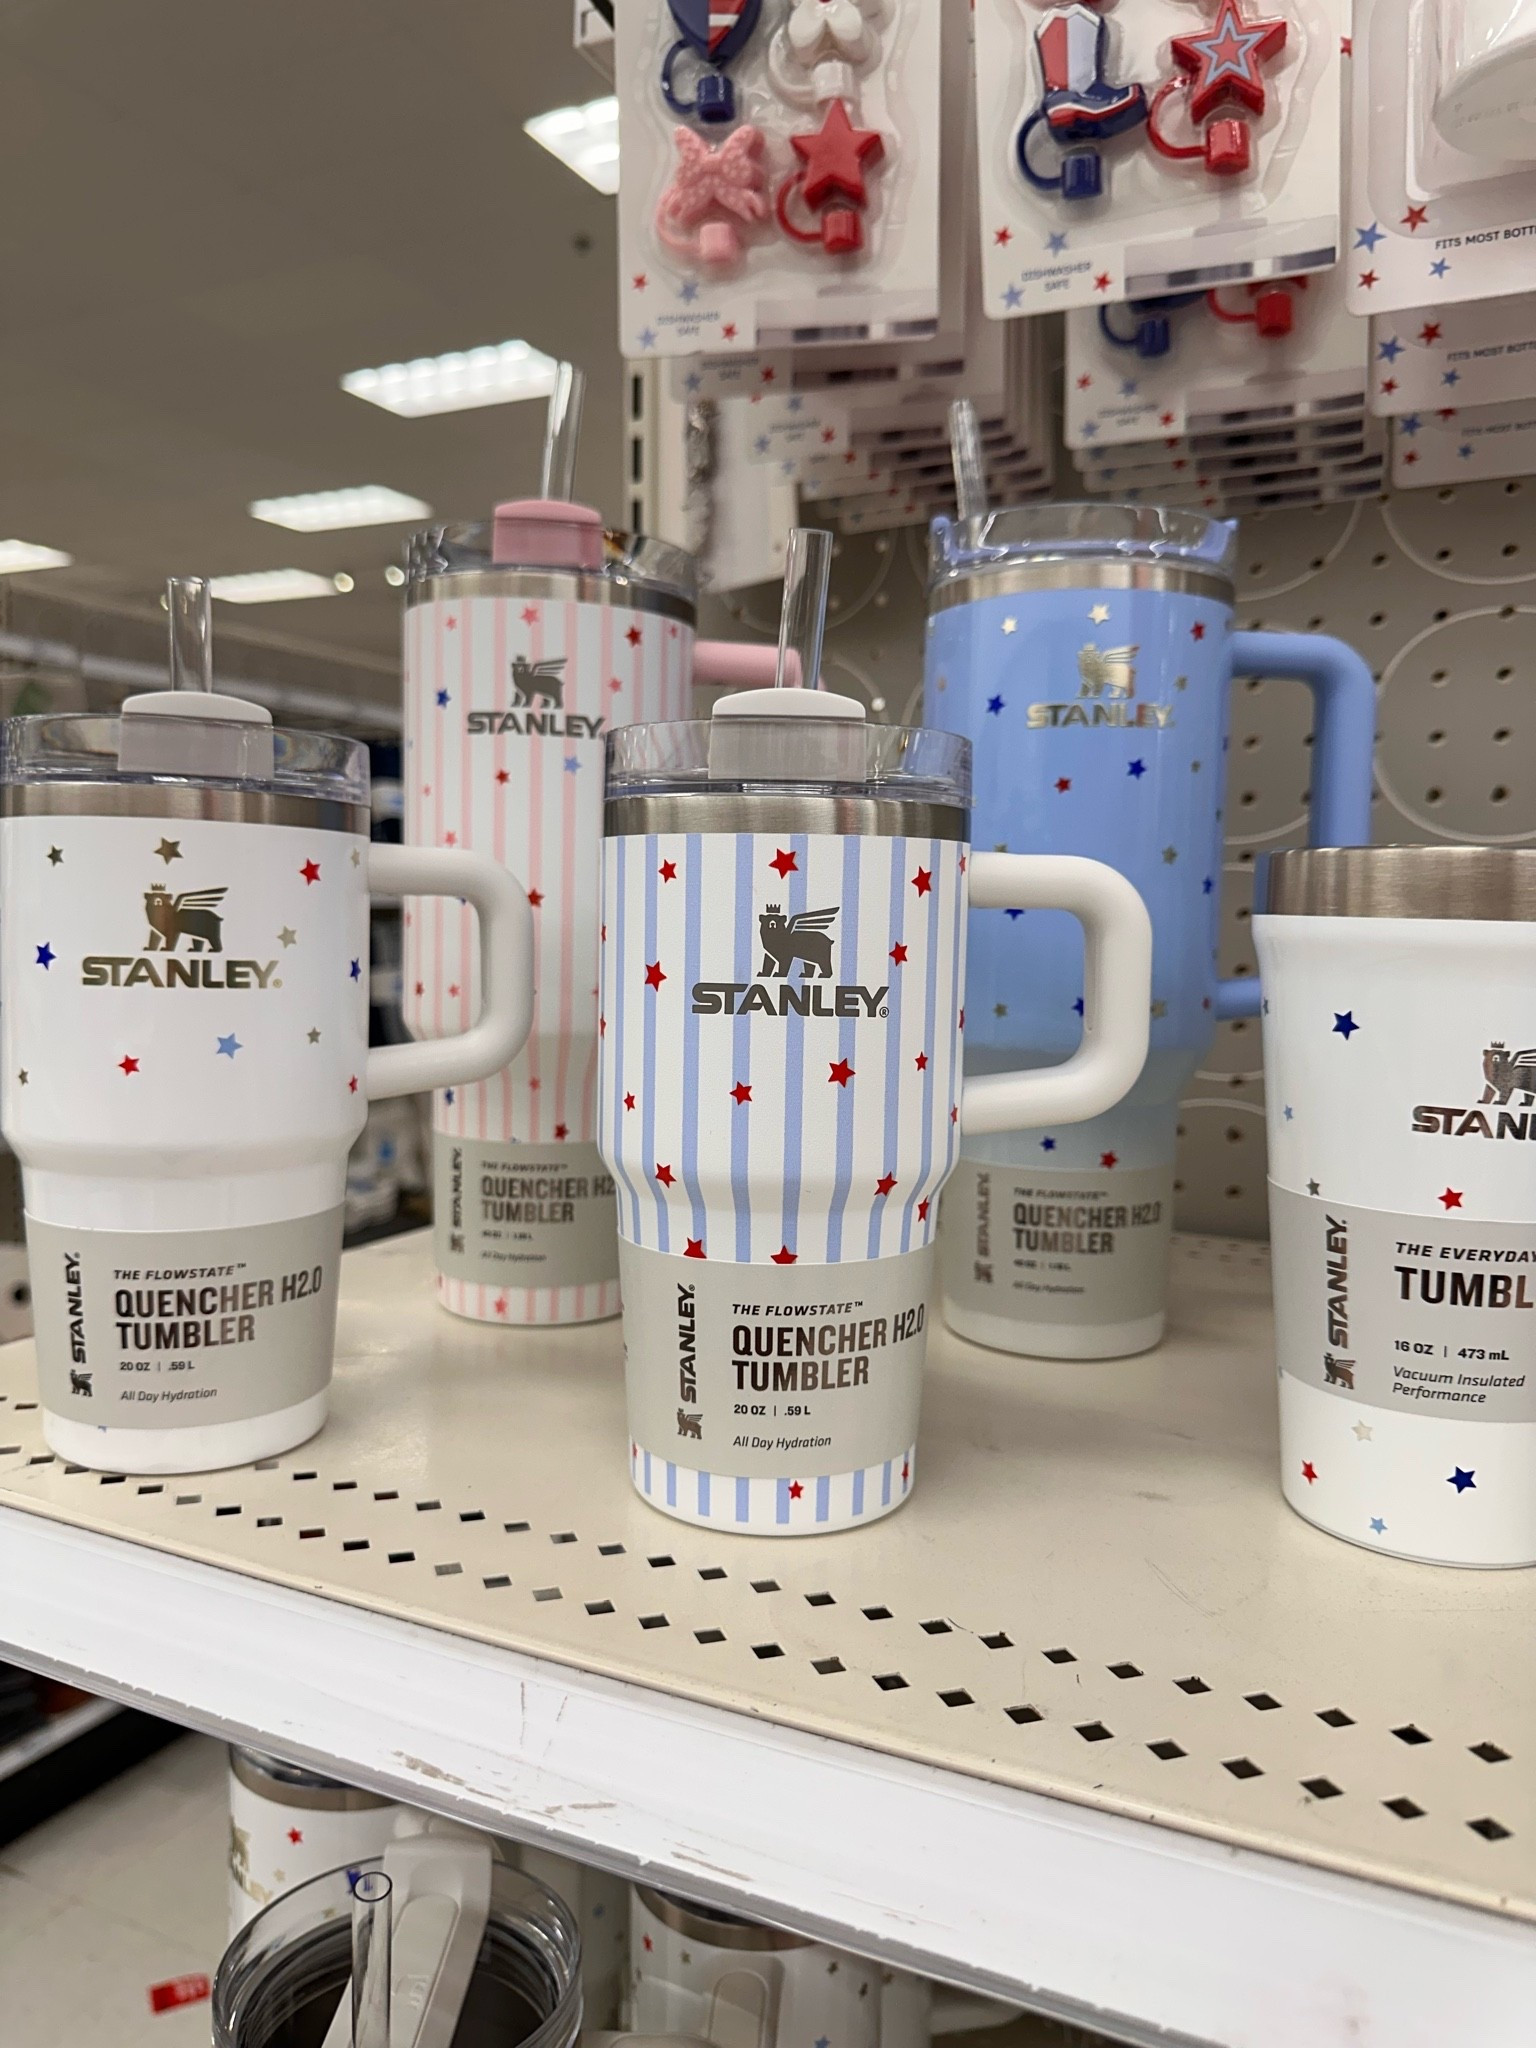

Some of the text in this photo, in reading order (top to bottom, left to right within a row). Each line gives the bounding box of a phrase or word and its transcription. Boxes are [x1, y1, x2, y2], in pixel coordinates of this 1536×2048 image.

[1435, 225, 1536, 250] FITS MOST BOTT
[467, 712, 605, 740] STANLEY
[481, 1176, 589, 1199] QUENCHER
[481, 1200, 575, 1223] TUMBLER
[1014, 1202, 1127, 1228] QUENCHER
[1013, 1228, 1114, 1254] TUMBLER
[1396, 1241, 1433, 1257] THE
[114, 1269, 141, 1280] THE
[115, 1265, 323, 1318] QUENCHER H2.0
[732, 1303, 761, 1316] THE
[115, 1313, 256, 1351] TUMBLER
[732, 1303, 925, 1357] QUENCHER H2.0
[1394, 1340, 1510, 1361] 16 OZ 473 mL
[120, 1360, 195, 1371] 20 OZ .59 L
[732, 1355, 869, 1392] TUMBLER
[1393, 1365, 1526, 1388] Vacuum Insulated
[120, 1387, 218, 1403] All Day Hydration
[1392, 1382, 1486, 1403] Performance
[733, 1404, 811, 1416] 20 OZ .59 L
[733, 1435, 832, 1451] All Day Hydration
